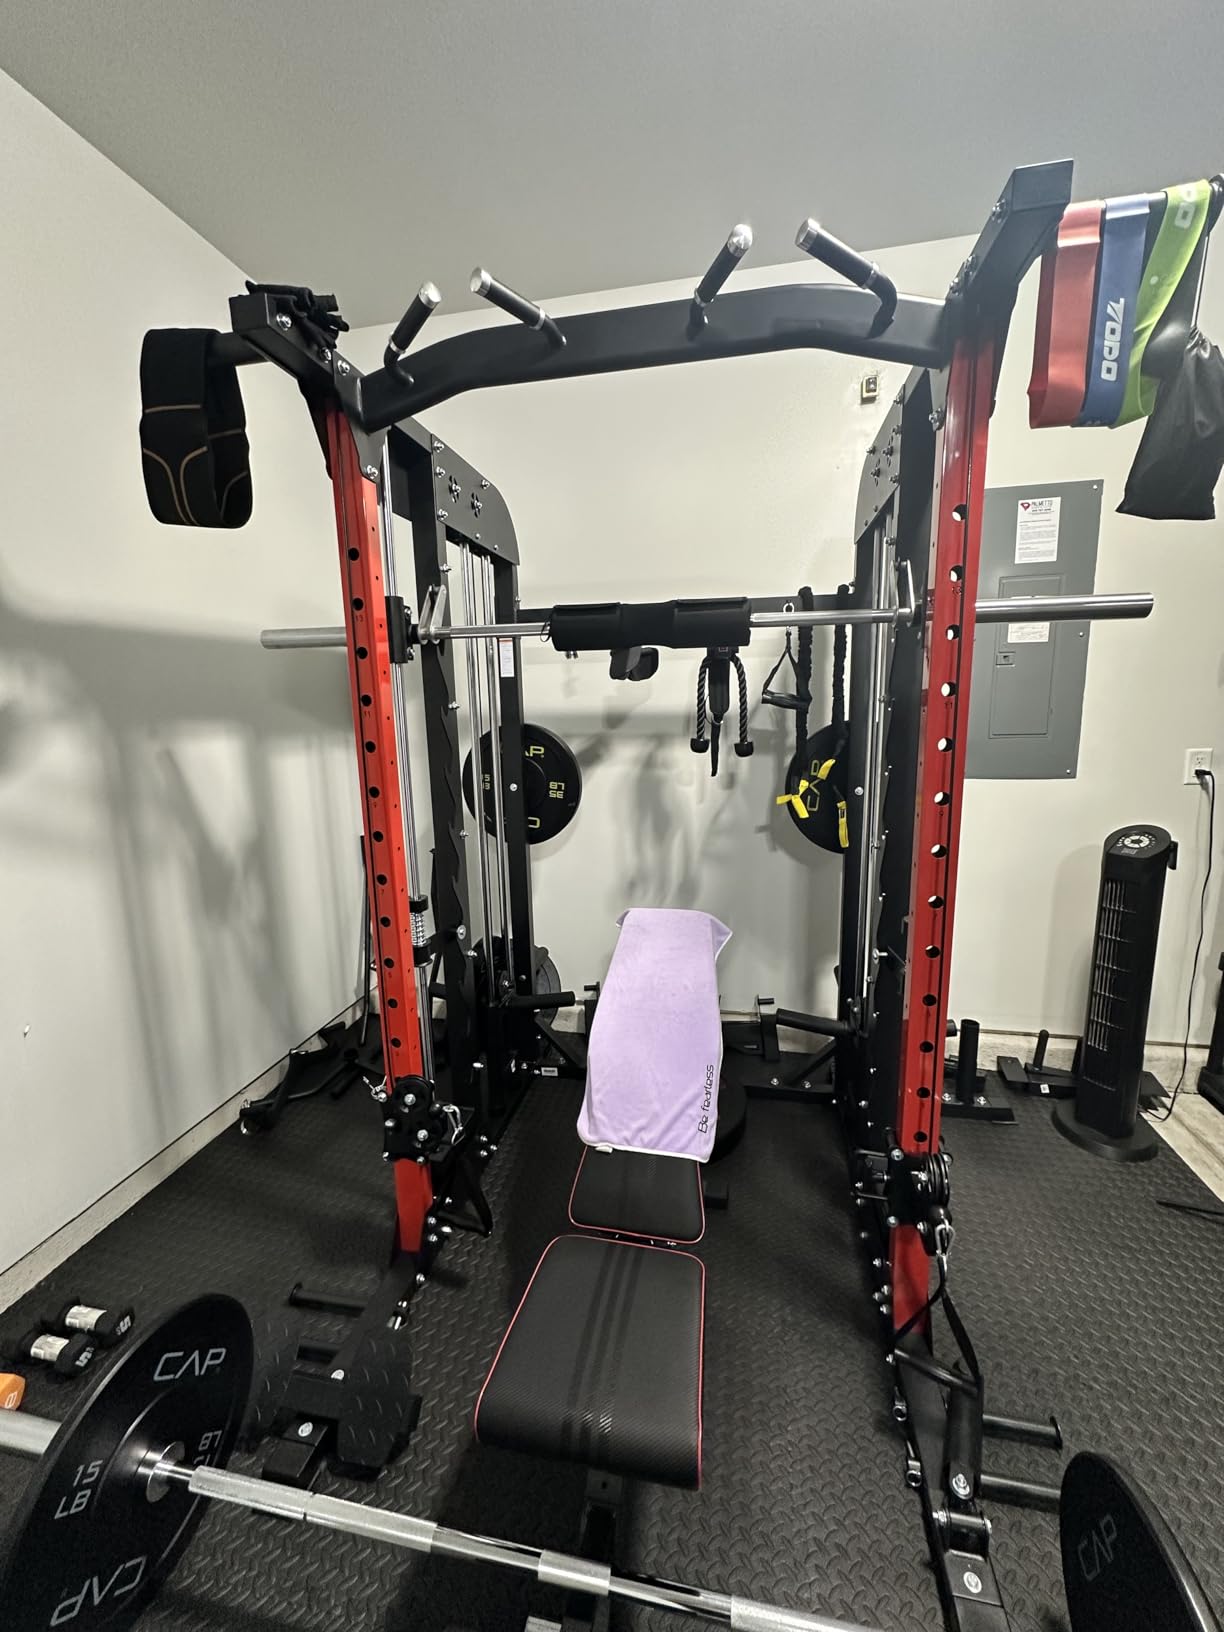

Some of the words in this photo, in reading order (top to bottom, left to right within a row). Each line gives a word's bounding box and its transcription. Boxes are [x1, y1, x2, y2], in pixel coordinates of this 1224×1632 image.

[700, 1064, 714, 1111] fearless
[697, 1114, 709, 1133] Be
[153, 1347, 227, 1381] CAP
[73, 1460, 104, 1487] 15
[55, 1489, 92, 1520] LB
[1077, 1514, 1118, 1582] CAP
[50, 1556, 147, 1628] CAP
